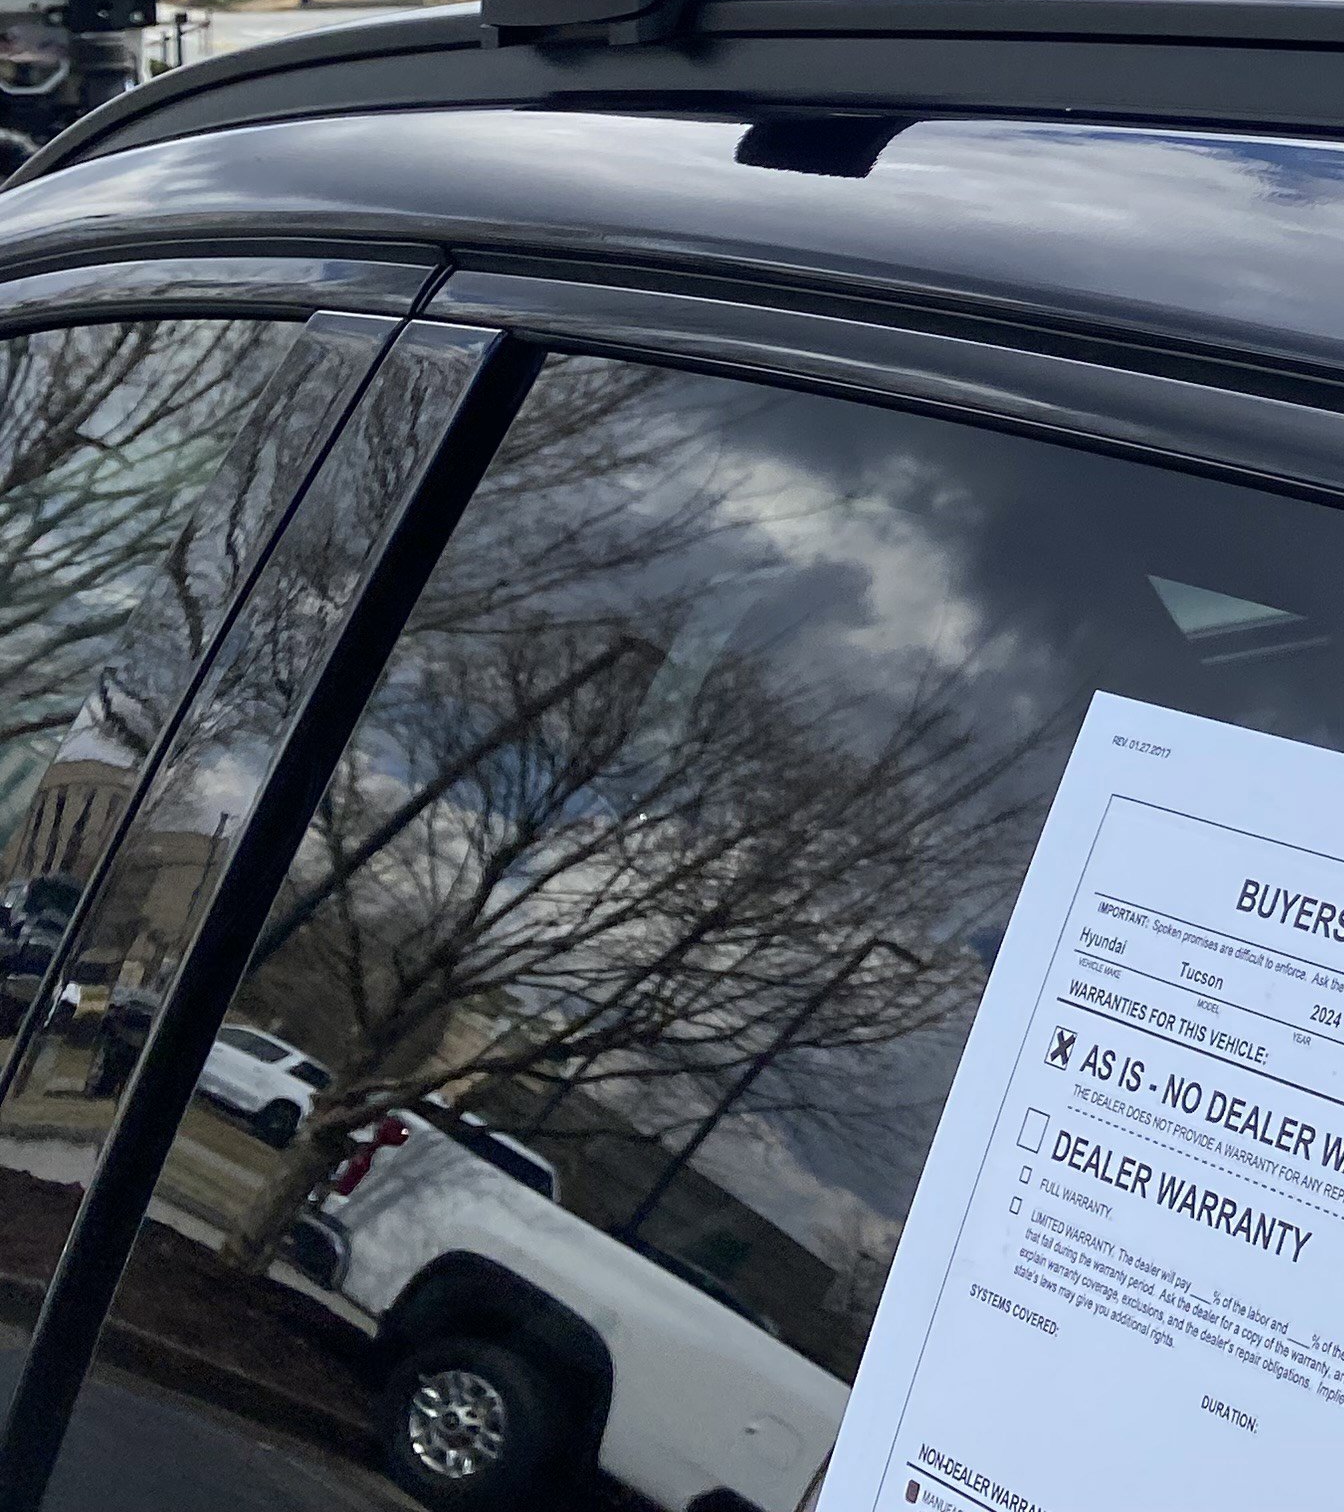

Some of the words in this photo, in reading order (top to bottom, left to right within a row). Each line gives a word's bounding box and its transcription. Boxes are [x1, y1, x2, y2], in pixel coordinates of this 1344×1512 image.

[1079, 926, 1129, 955] Hyundai
[1097, 901, 1150, 929] IMPORTANT:
[1151, 918, 1183, 940] Spoken
[1180, 931, 1219, 952] promises
[1219, 944, 1234, 957] are
[1234, 947, 1265, 967] difficult
[1264, 957, 1274, 970] to
[1274, 962, 1307, 982] enforce.
[1310, 972, 1330, 989] Ask
[1078, 956, 1105, 974] VEHICLE
[1102, 965, 1123, 982] MAKE
[1179, 960, 1224, 991] Tucson
[1069, 978, 1148, 1021] WARRANTIES
[1147, 1008, 1177, 1032] FOR
[1177, 1017, 1208, 1043] THIS
[1209, 1028, 1270, 1066] VEHICLE:
[1196, 997, 1220, 1017] MODEL
[1309, 1004, 1343, 1029] 2024
[1292, 1031, 1312, 1047] YEAR
[1078, 1044, 1117, 1081] AS
[1117, 1056, 1145, 1093] IS
[1160, 1073, 1203, 1114] NO
[1204, 1089, 1317, 1161] DEALER
[1073, 1083, 1092, 1102] THE
[1090, 1090, 1126, 1116] DEALER
[1125, 1104, 1153, 1126] DOES
[1151, 1115, 1174, 1134] NOT
[1171, 1123, 1216, 1151] PROVIDE
[1213, 1141, 1223, 1155] A
[1223, 1143, 1280, 1176] WARRANTY
[1278, 1165, 1301, 1185] FOR
[1299, 1174, 1324, 1194] ANY
[1039, 1177, 1061, 1199] FULL
[1062, 1187, 1114, 1220] WARRANTY.
[1050, 1129, 1153, 1200] DEALER
[1156, 1171, 1313, 1263] WARRANTY
[1013, 1264, 1039, 1284] state's
[1039, 1273, 1058, 1293] laws
[1057, 1286, 1076, 1304] may
[1074, 1293, 1094, 1310] give
[1092, 1302, 1111, 1318] you
[1109, 1310, 1152, 1337] additional
[1149, 1327, 1175, 1349] rights.
[1024, 1227, 1042, 1245] that
[1040, 1233, 1055, 1250] fail
[1053, 1241, 1079, 1265] during
[1078, 1252, 1093, 1268] the
[1092, 1260, 1128, 1286] warranty
[1126, 1276, 1156, 1297] period.
[1158, 1288, 1177, 1306] Ask
[1176, 1296, 1191, 1313] the
[1191, 1303, 1221, 1325] dealer
[1219, 1314, 1235, 1332] for
[1232, 1324, 1241, 1336] a
[1240, 1327, 1264, 1349] copy
[1263, 1337, 1276, 1350] of
[1274, 1340, 1290, 1358] the
[1290, 1349, 1331, 1379] warranty,
[1030, 1209, 1066, 1235] LIMITED
[1064, 1224, 1116, 1258] WARRANTY.
[1118, 1247, 1134, 1267] The
[1133, 1256, 1161, 1278] dealer
[1160, 1269, 1177, 1285] will
[1173, 1276, 1192, 1294] pay
[1221, 1297, 1234, 1310] of
[1231, 1298, 1247, 1317] the
[1246, 1305, 1271, 1327] labor
[1269, 1319, 1290, 1335] and
[1321, 1341, 1334, 1355] of
[969, 1283, 1012, 1314] SYSTEMS
[1012, 1303, 1060, 1338] COVERED:
[1019, 1247, 1047, 1267] explain
[1047, 1259, 1082, 1286] warranty
[1081, 1276, 1119, 1305] coverage,
[1121, 1294, 1165, 1325] exclusions,
[1166, 1315, 1186, 1331] and
[1184, 1321, 1199, 1338] the
[1199, 1328, 1235, 1354] dealer's
[1234, 1346, 1262, 1366] repair
[1261, 1357, 1311, 1392] obligations.
[1200, 1394, 1259, 1435] DURATION:
[917, 1442, 991, 1498] NON-DEALER
